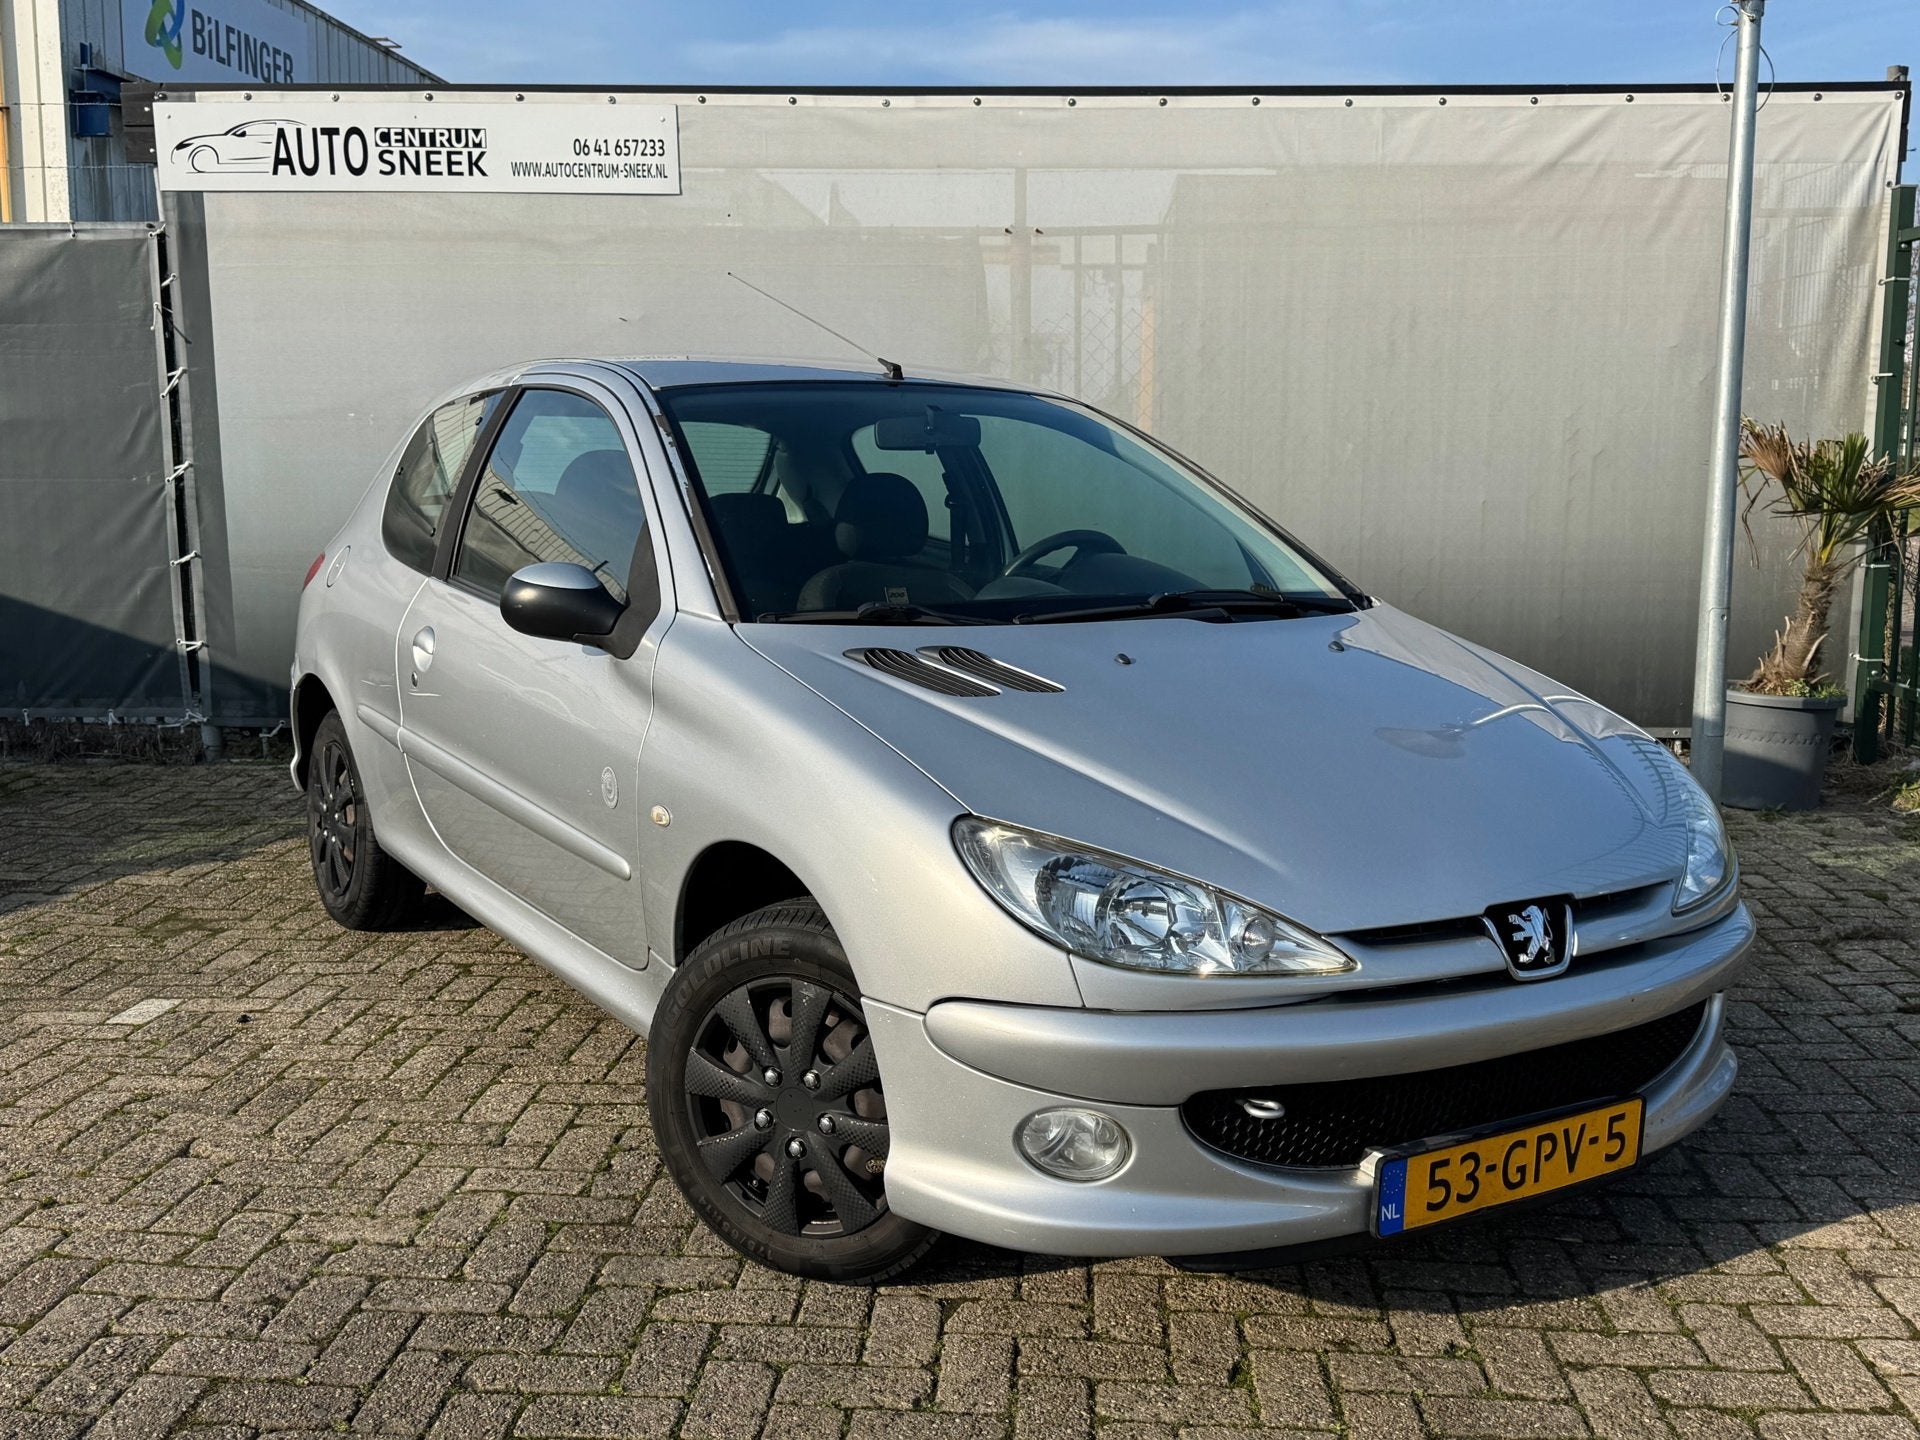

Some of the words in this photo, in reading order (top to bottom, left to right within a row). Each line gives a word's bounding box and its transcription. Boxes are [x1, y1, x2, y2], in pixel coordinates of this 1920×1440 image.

[272, 126, 369, 177] AUTO
[374, 127, 487, 149] CENTRUM
[573, 138, 591, 157] 06
[594, 138, 611, 157] 41
[614, 138, 666, 157] 657233
[378, 149, 489, 177] SNEEK
[511, 161, 668, 179] WWW.AUTOCENTRUM-SNEEK.NL
[663, 934, 794, 1027] GOLDLINE
[1425, 1112, 1627, 1212] 53-GPV-5
[1381, 1203, 1400, 1222] NL
